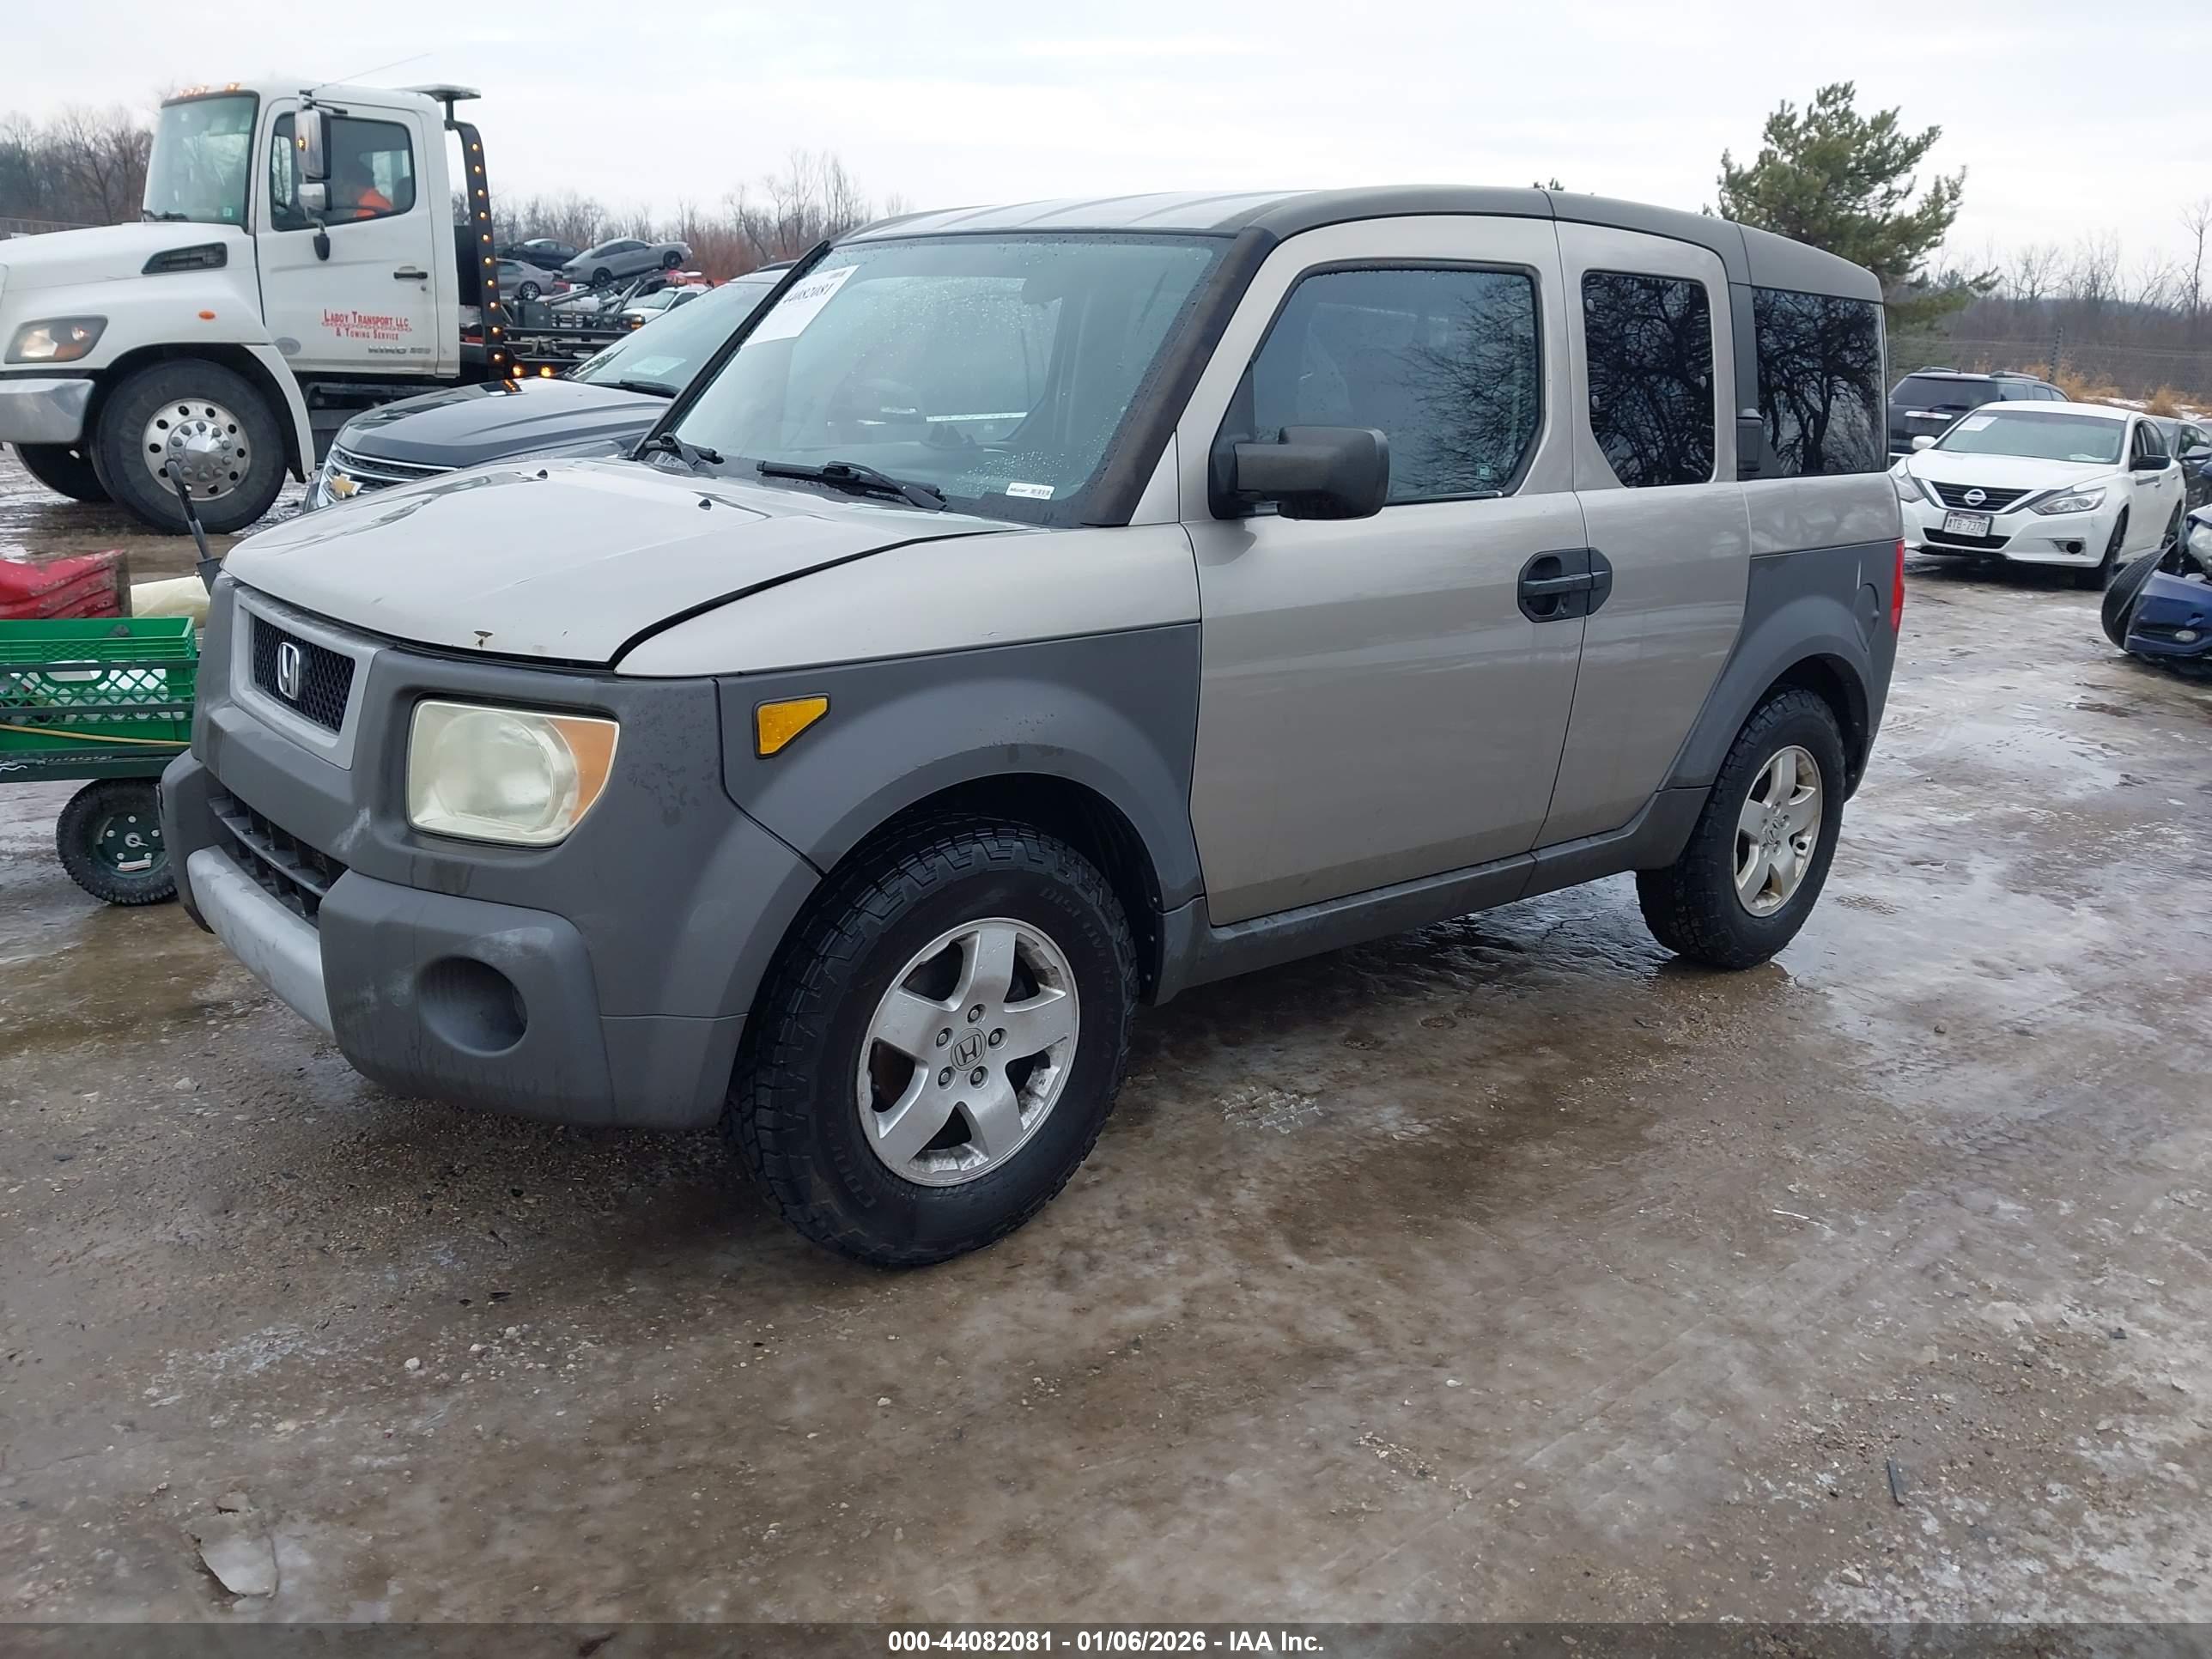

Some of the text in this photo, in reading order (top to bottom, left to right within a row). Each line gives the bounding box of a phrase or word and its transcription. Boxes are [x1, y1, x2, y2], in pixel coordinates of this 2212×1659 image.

[351, 311, 393, 325] TRANSPORT
[395, 317, 410, 327] LLC
[336, 327, 399, 341] & TOWING SERVICE
